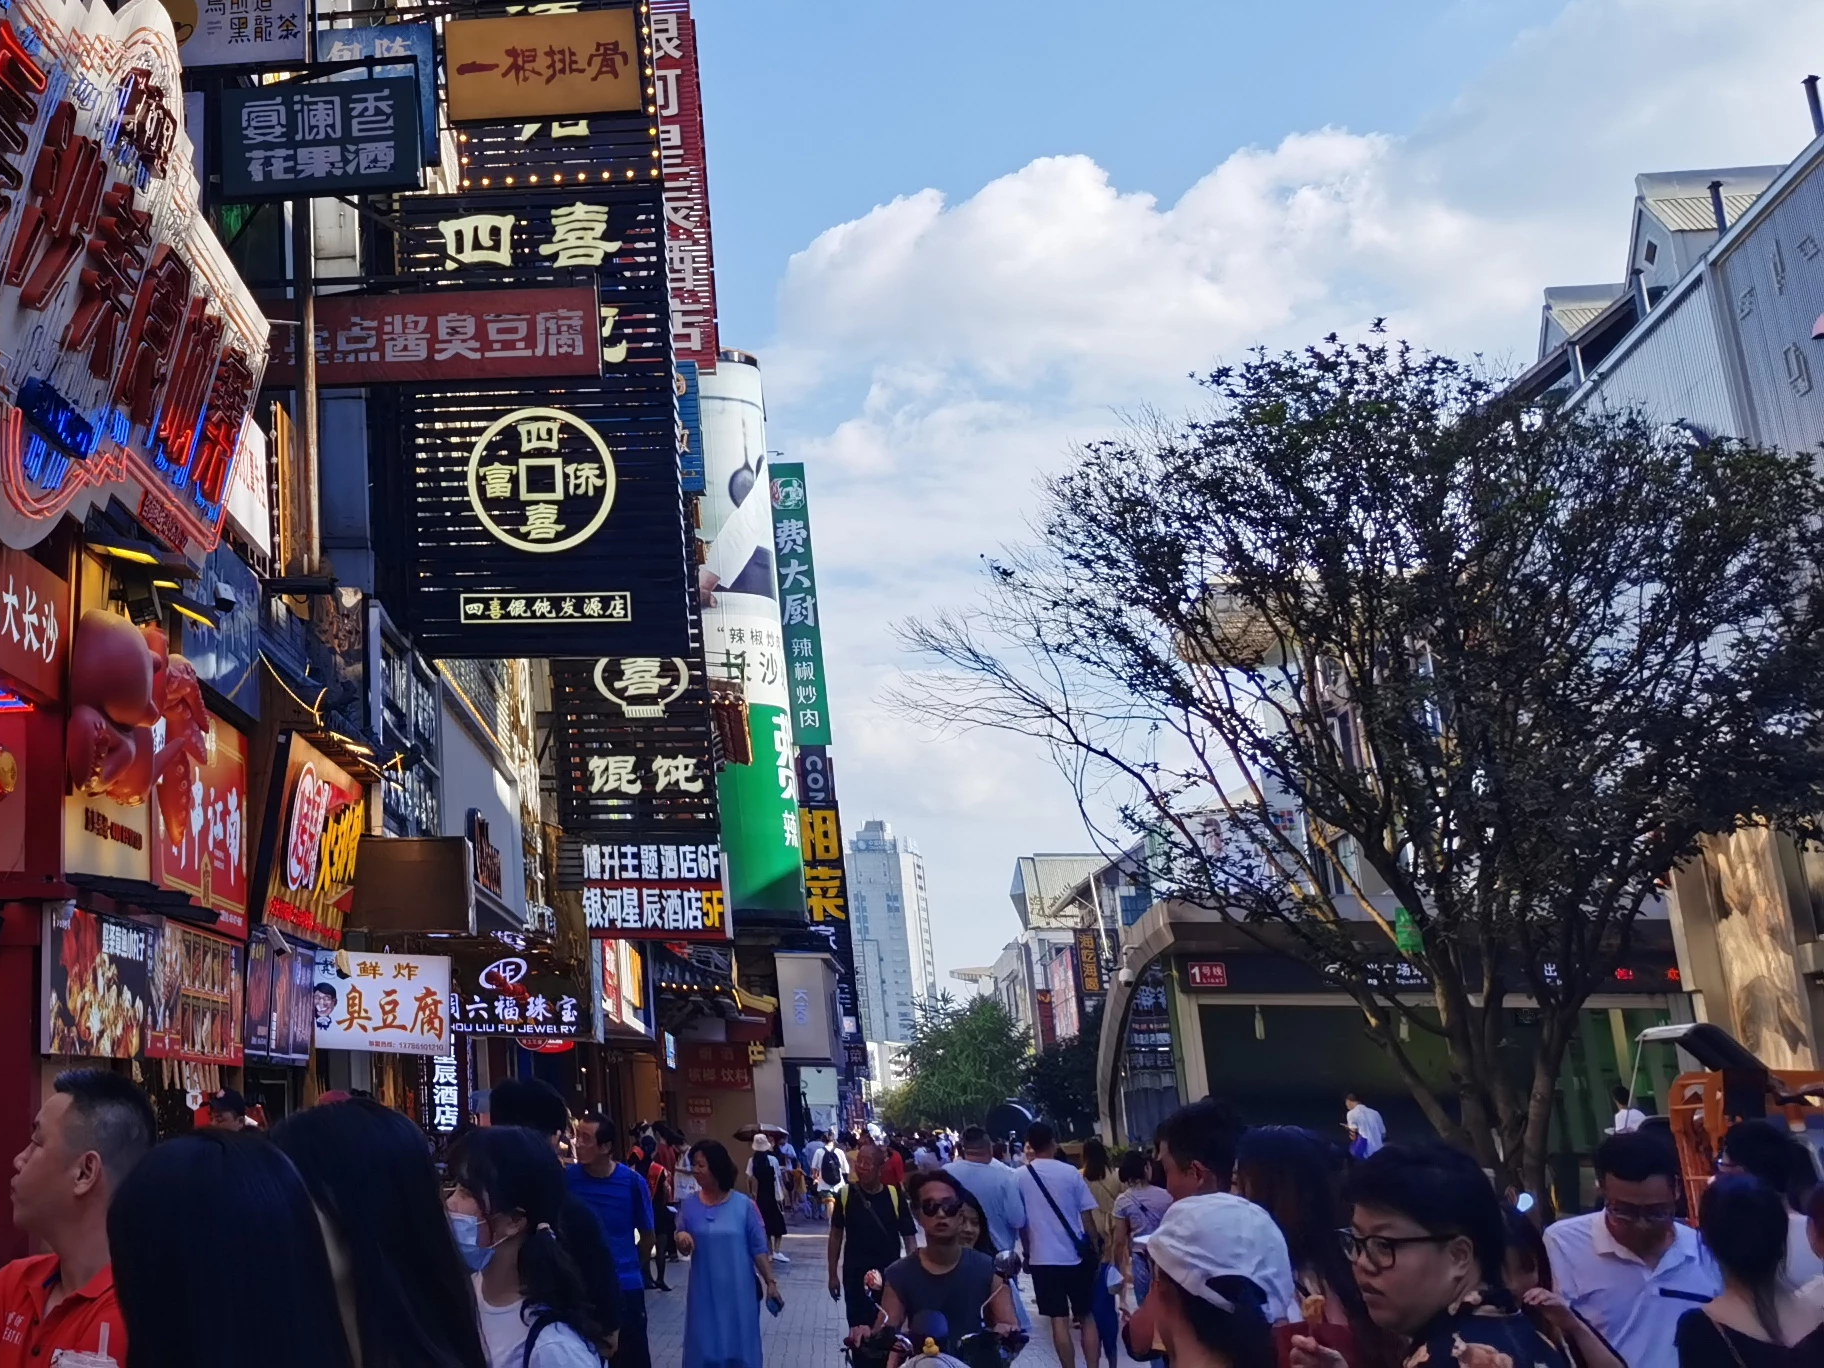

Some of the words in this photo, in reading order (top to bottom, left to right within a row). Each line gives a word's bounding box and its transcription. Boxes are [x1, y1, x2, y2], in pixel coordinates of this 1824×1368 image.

[456, 39, 629, 87] 一根排骨
[245, 140, 395, 182] 花果酒
[438, 201, 623, 272] 四喜
[776, 518, 816, 628] 费大厨
[465, 597, 628, 620] 四喜馄饨发源店
[791, 637, 819, 729] 辣椒炒肉
[587, 753, 704, 795] 馄饨
[581, 886, 724, 930] 银河星辰酒店5F
[335, 983, 445, 1041] 臭豆腐
[451, 1023, 474, 1033] HOU
[476, 1023, 495, 1033] LIU
[498, 1023, 515, 1033] FU
[518, 1024, 577, 1034] JEWELRY
